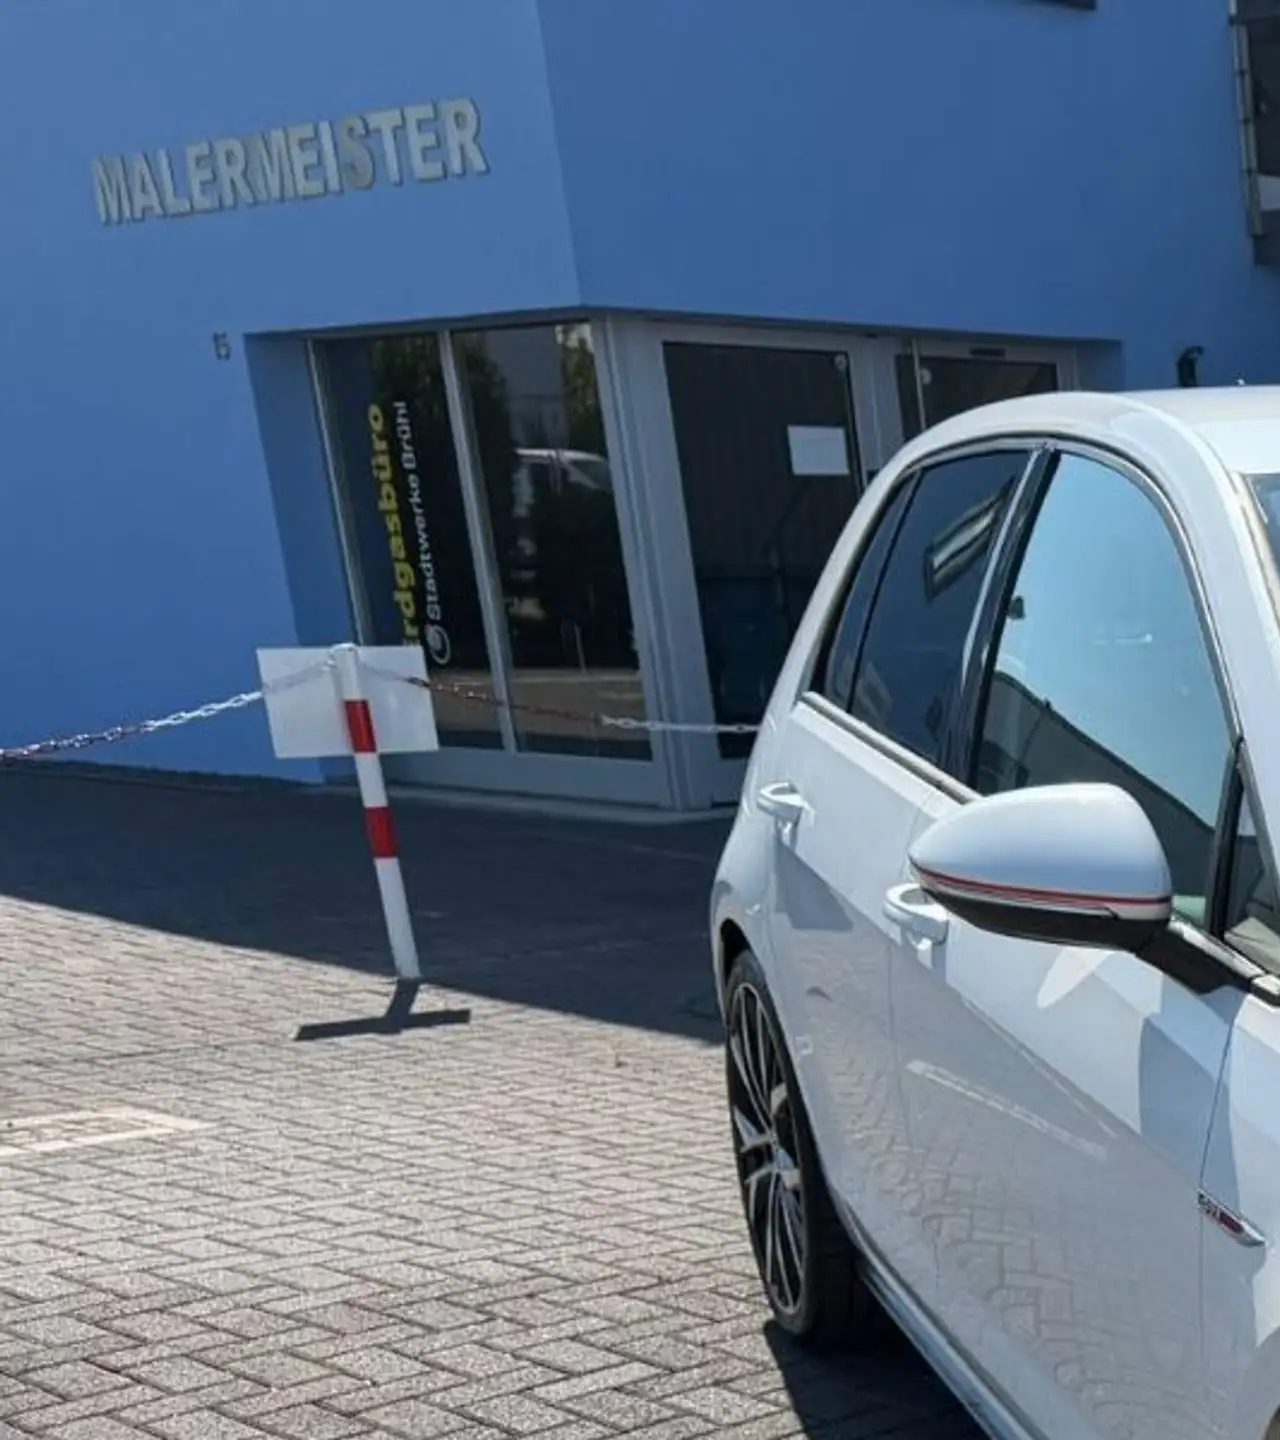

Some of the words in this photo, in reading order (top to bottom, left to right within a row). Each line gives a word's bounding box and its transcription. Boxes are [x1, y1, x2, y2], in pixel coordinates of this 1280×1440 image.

[92, 97, 490, 226] MALERMEISTER
[393, 401, 417, 469] Brühl
[408, 473, 441, 620] Stadtwerke
